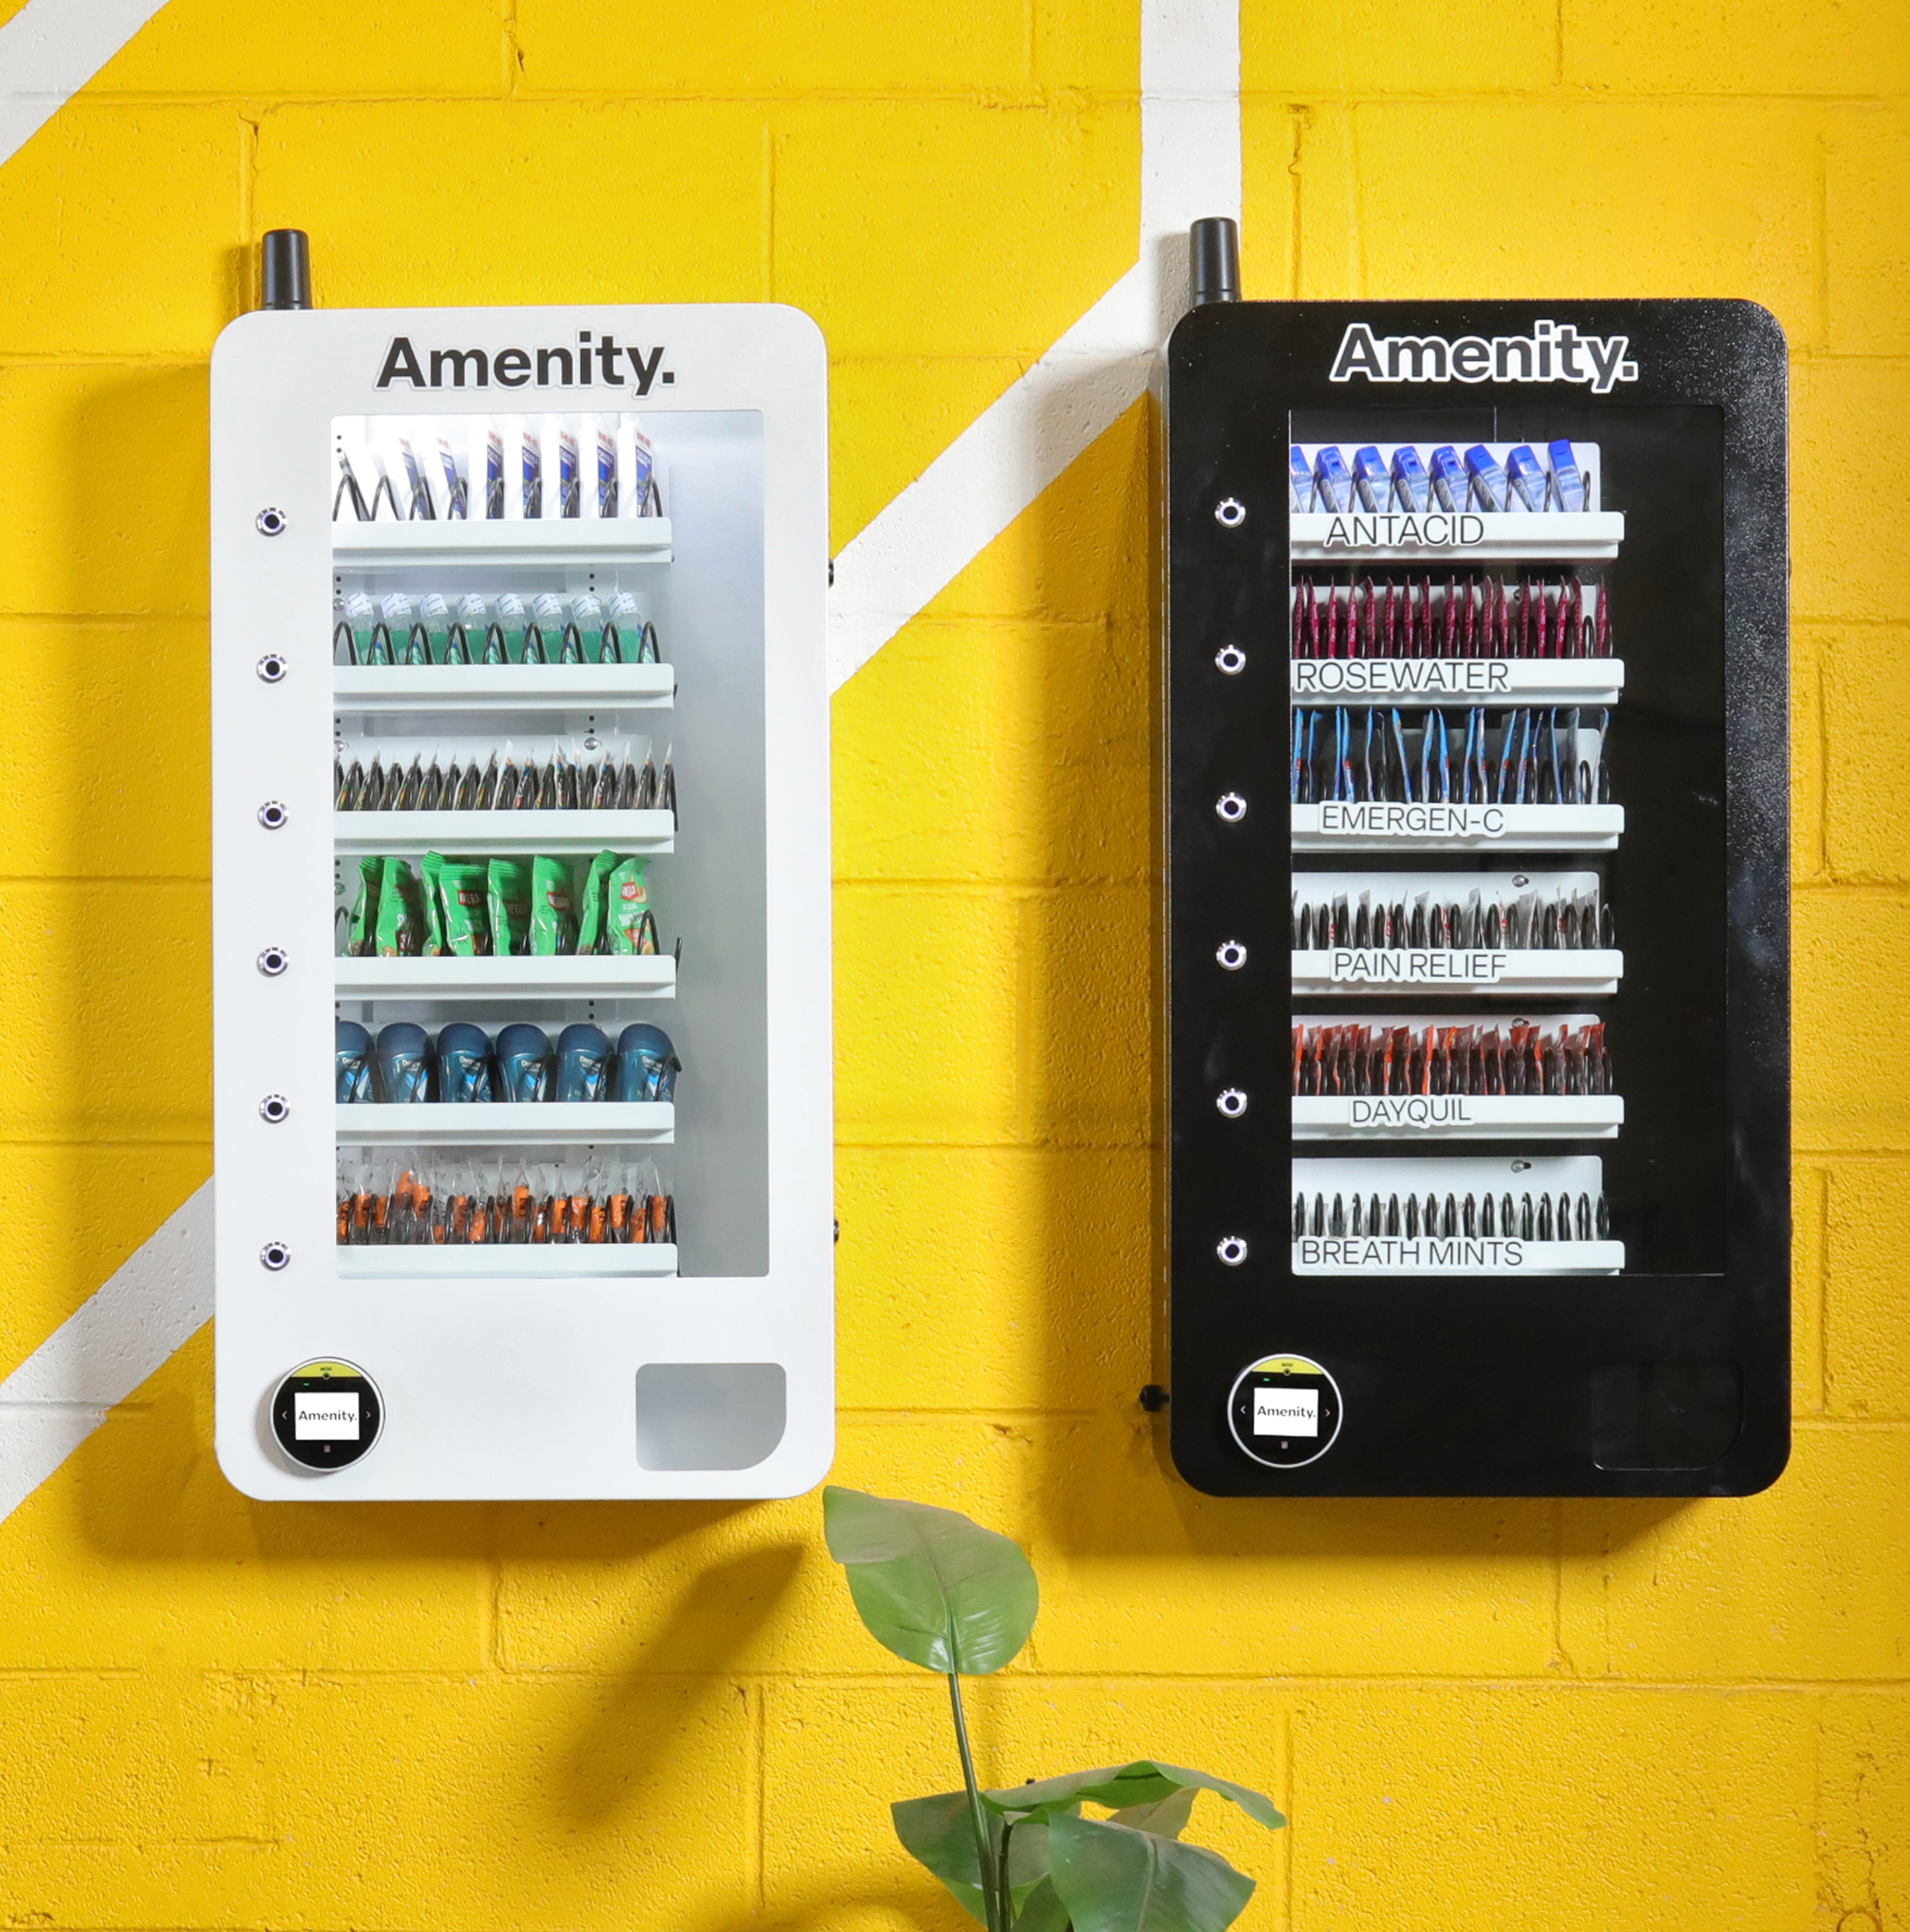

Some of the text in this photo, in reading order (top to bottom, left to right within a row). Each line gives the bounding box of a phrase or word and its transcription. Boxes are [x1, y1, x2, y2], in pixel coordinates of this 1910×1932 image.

[376, 330, 675, 396] Amenity.
[1333, 322, 1635, 391] Amenity.
[1325, 515, 1484, 545] ANTACID
[1296, 662, 1508, 689] ROSEWATER
[1323, 805, 1504, 832] EMERGEN-C
[1335, 952, 1507, 978] PAIN RELIEF
[1352, 1099, 1471, 1124] DAYQUIL
[1301, 1240, 1523, 1266] BREATH MINTS
[298, 1409, 357, 1423] Amenity.
[1257, 1406, 1316, 1420] Amenity.
